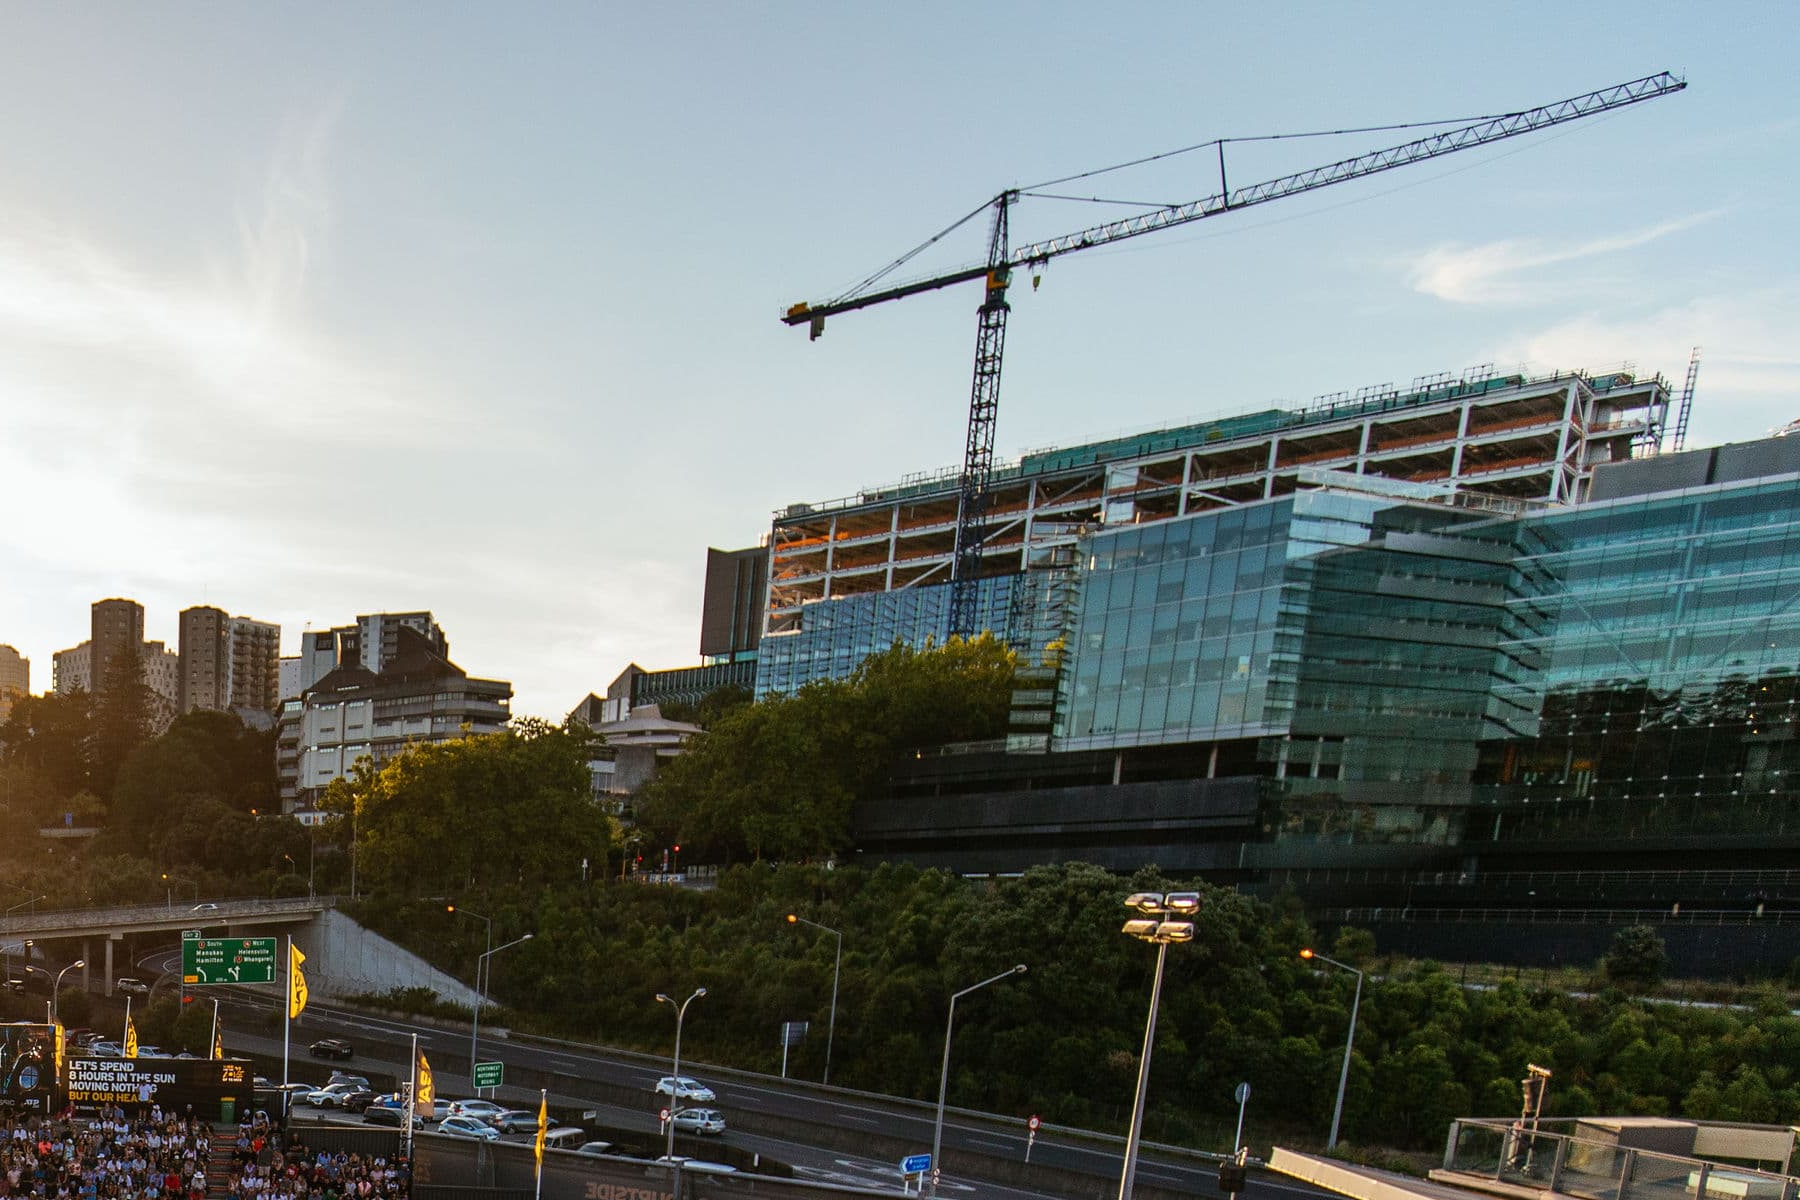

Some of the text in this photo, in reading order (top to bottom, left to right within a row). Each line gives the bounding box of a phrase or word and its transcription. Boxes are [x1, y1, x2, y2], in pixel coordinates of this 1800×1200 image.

[69, 1060, 134, 1072] LET'S SPEND
[69, 1071, 176, 1084] 8 HOURS IN THE SUN
[69, 1081, 158, 1093] MOVING NOTHG
[69, 1092, 90, 1101] BUT
[92, 1093, 114, 1102] OUR
